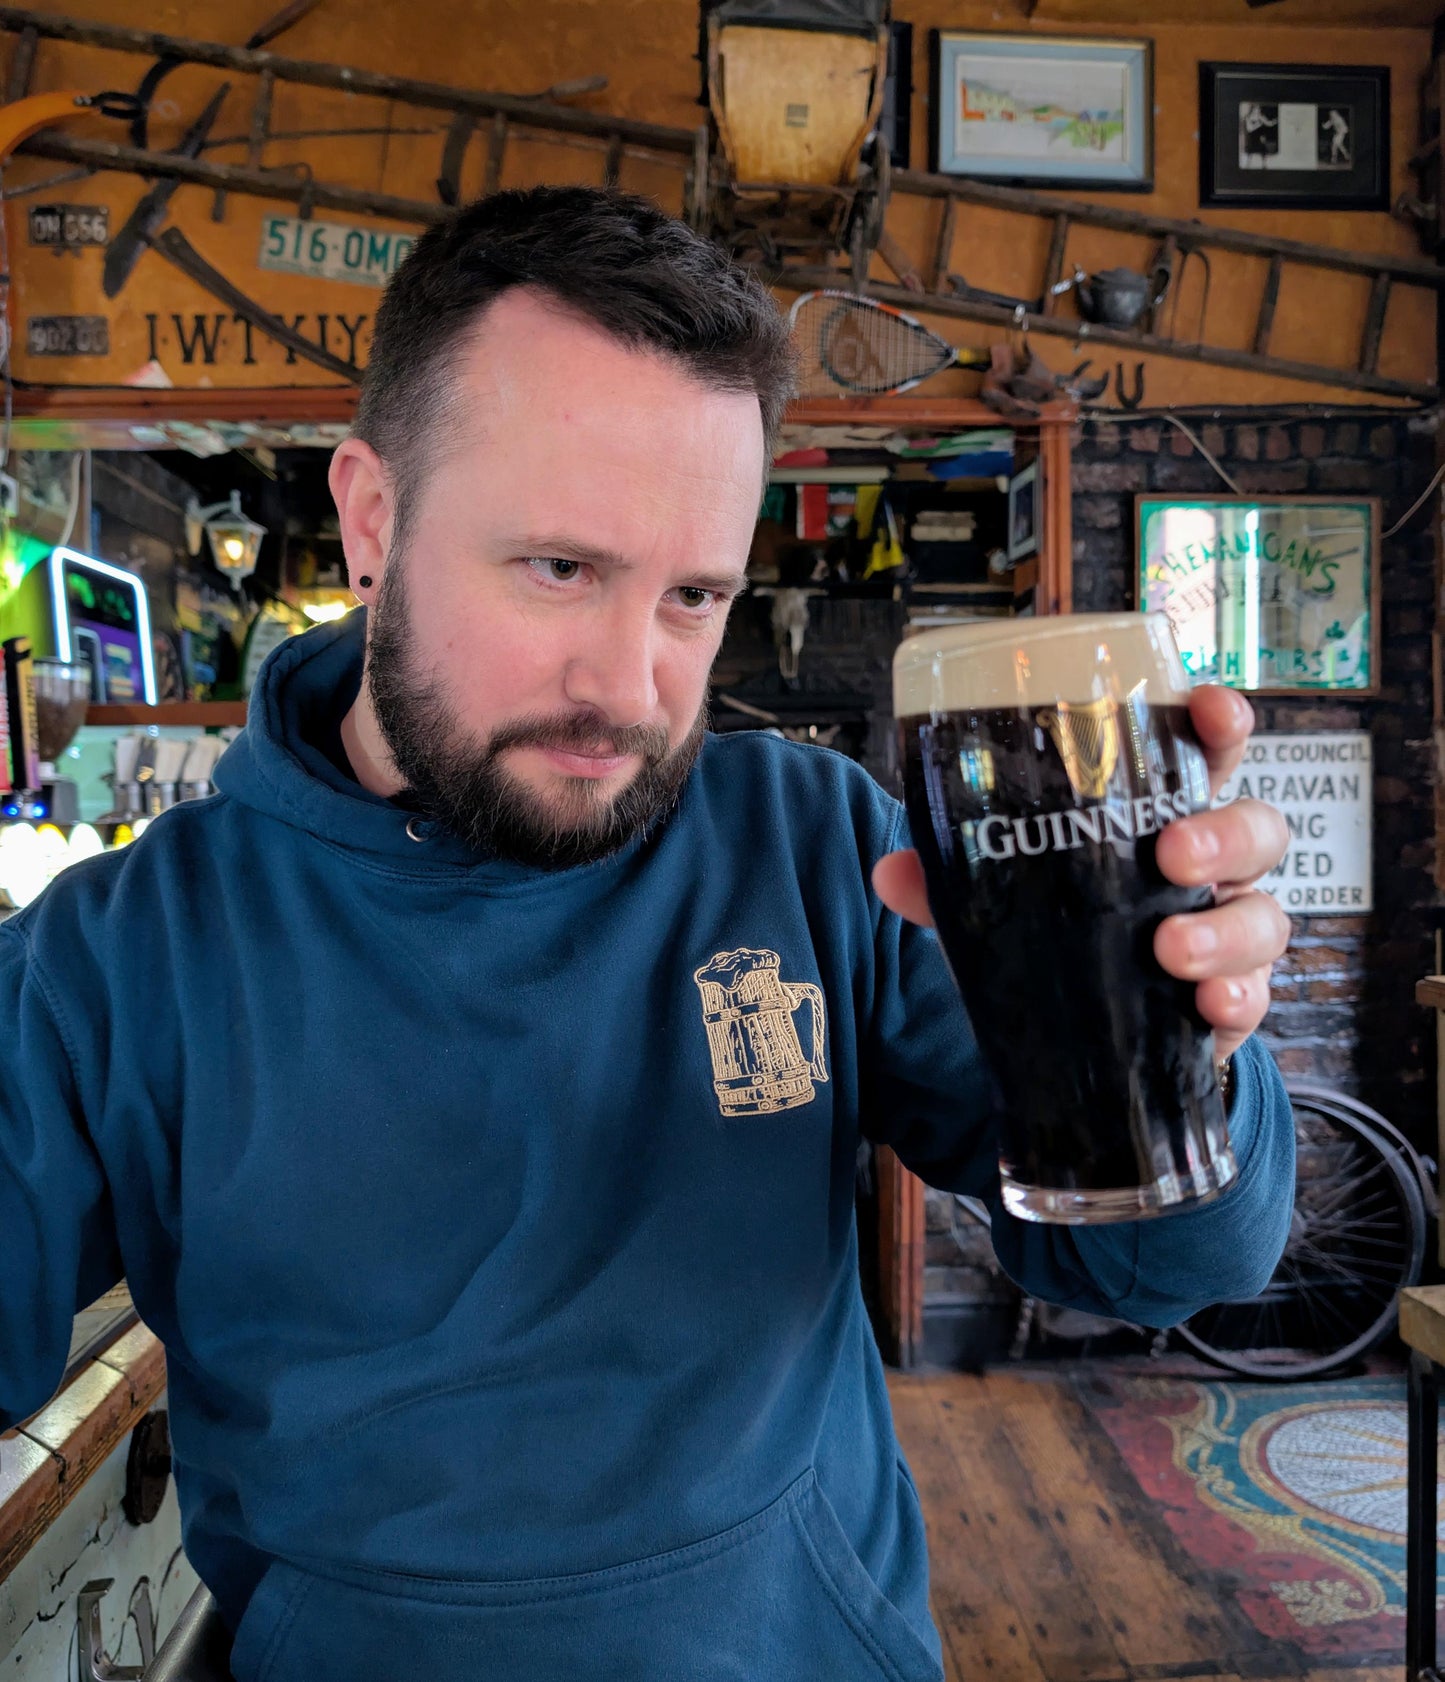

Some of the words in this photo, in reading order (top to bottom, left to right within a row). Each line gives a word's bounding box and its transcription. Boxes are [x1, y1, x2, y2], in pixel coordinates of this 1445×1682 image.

[1275, 743, 1371, 764] COUNCIL
[975, 791, 1193, 861] GUINNESS
[1287, 886, 1362, 906] ORDER
